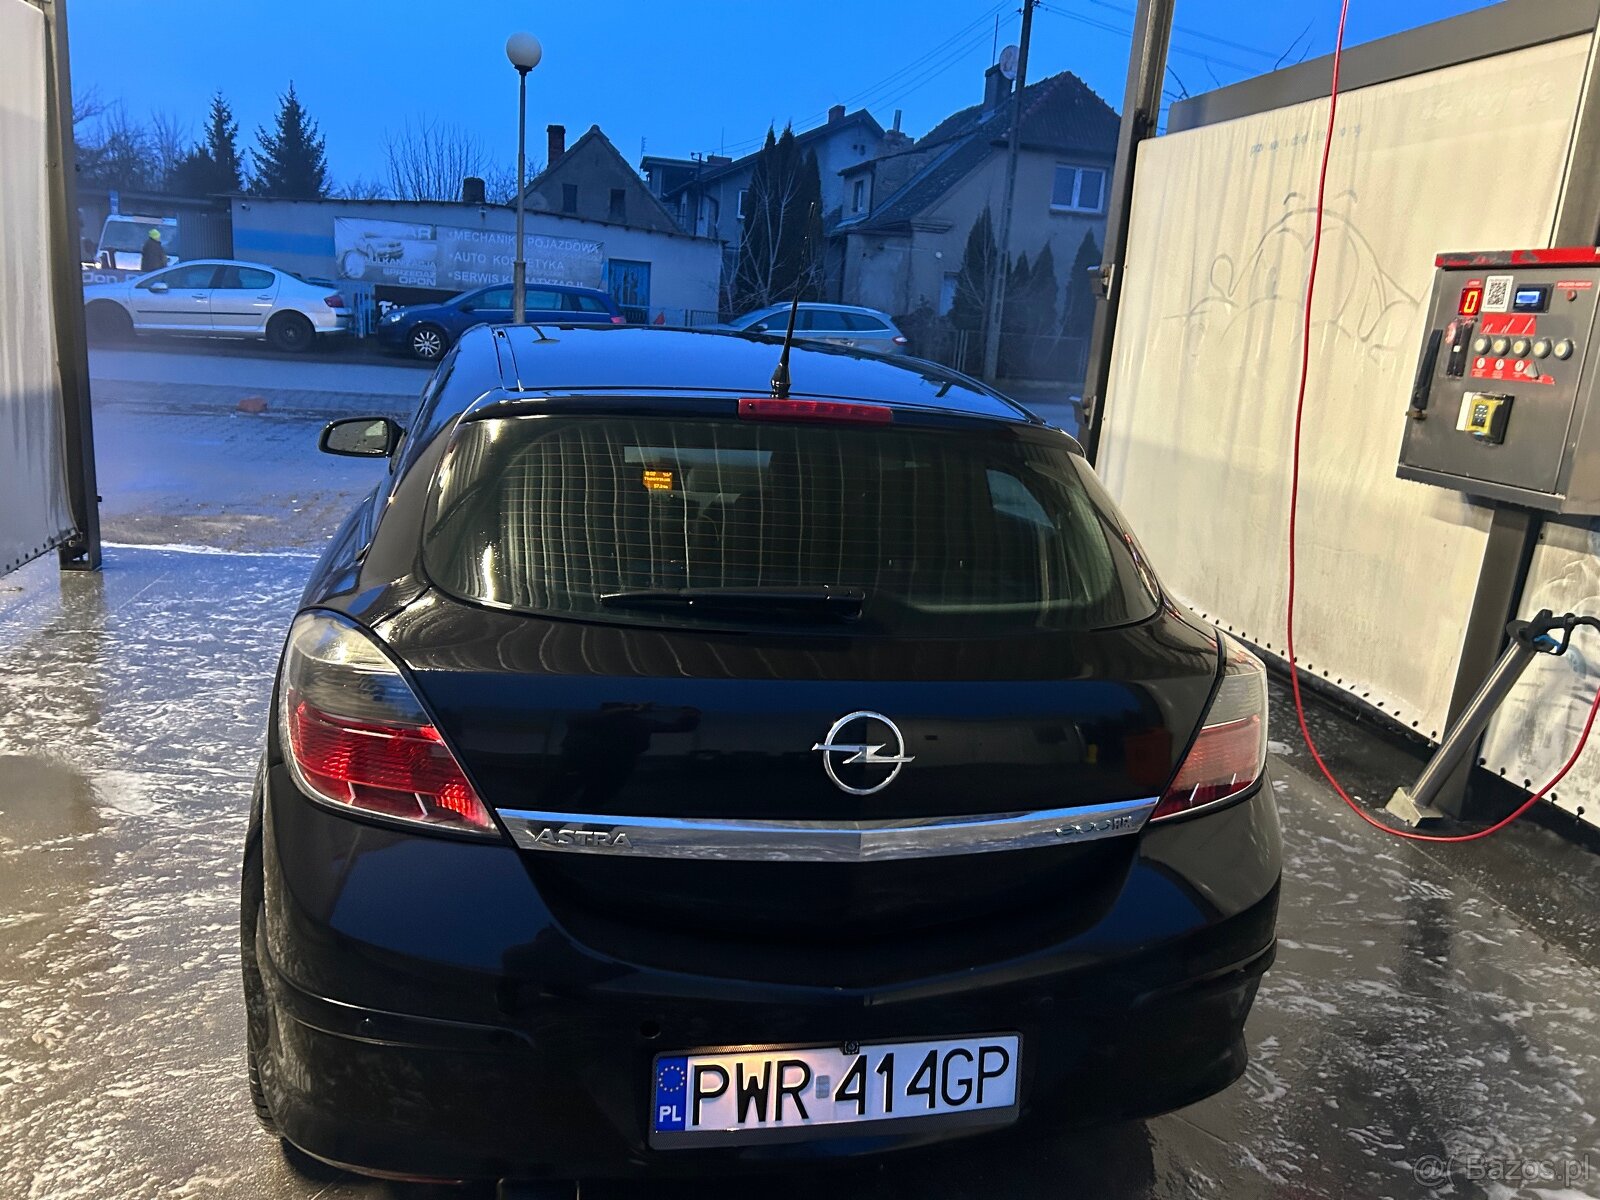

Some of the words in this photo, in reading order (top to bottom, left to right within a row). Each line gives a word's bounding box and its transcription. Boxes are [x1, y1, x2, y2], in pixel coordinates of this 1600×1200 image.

[454, 251, 487, 264] AUTO
[398, 276, 437, 287] OPON
[454, 270, 499, 284] SERWIS
[1463, 290, 1478, 313] 0
[527, 827, 633, 849] ASTRA
[692, 1058, 812, 1126] PWR
[834, 1045, 1010, 1116] 414GP
[659, 1105, 682, 1123] PL
